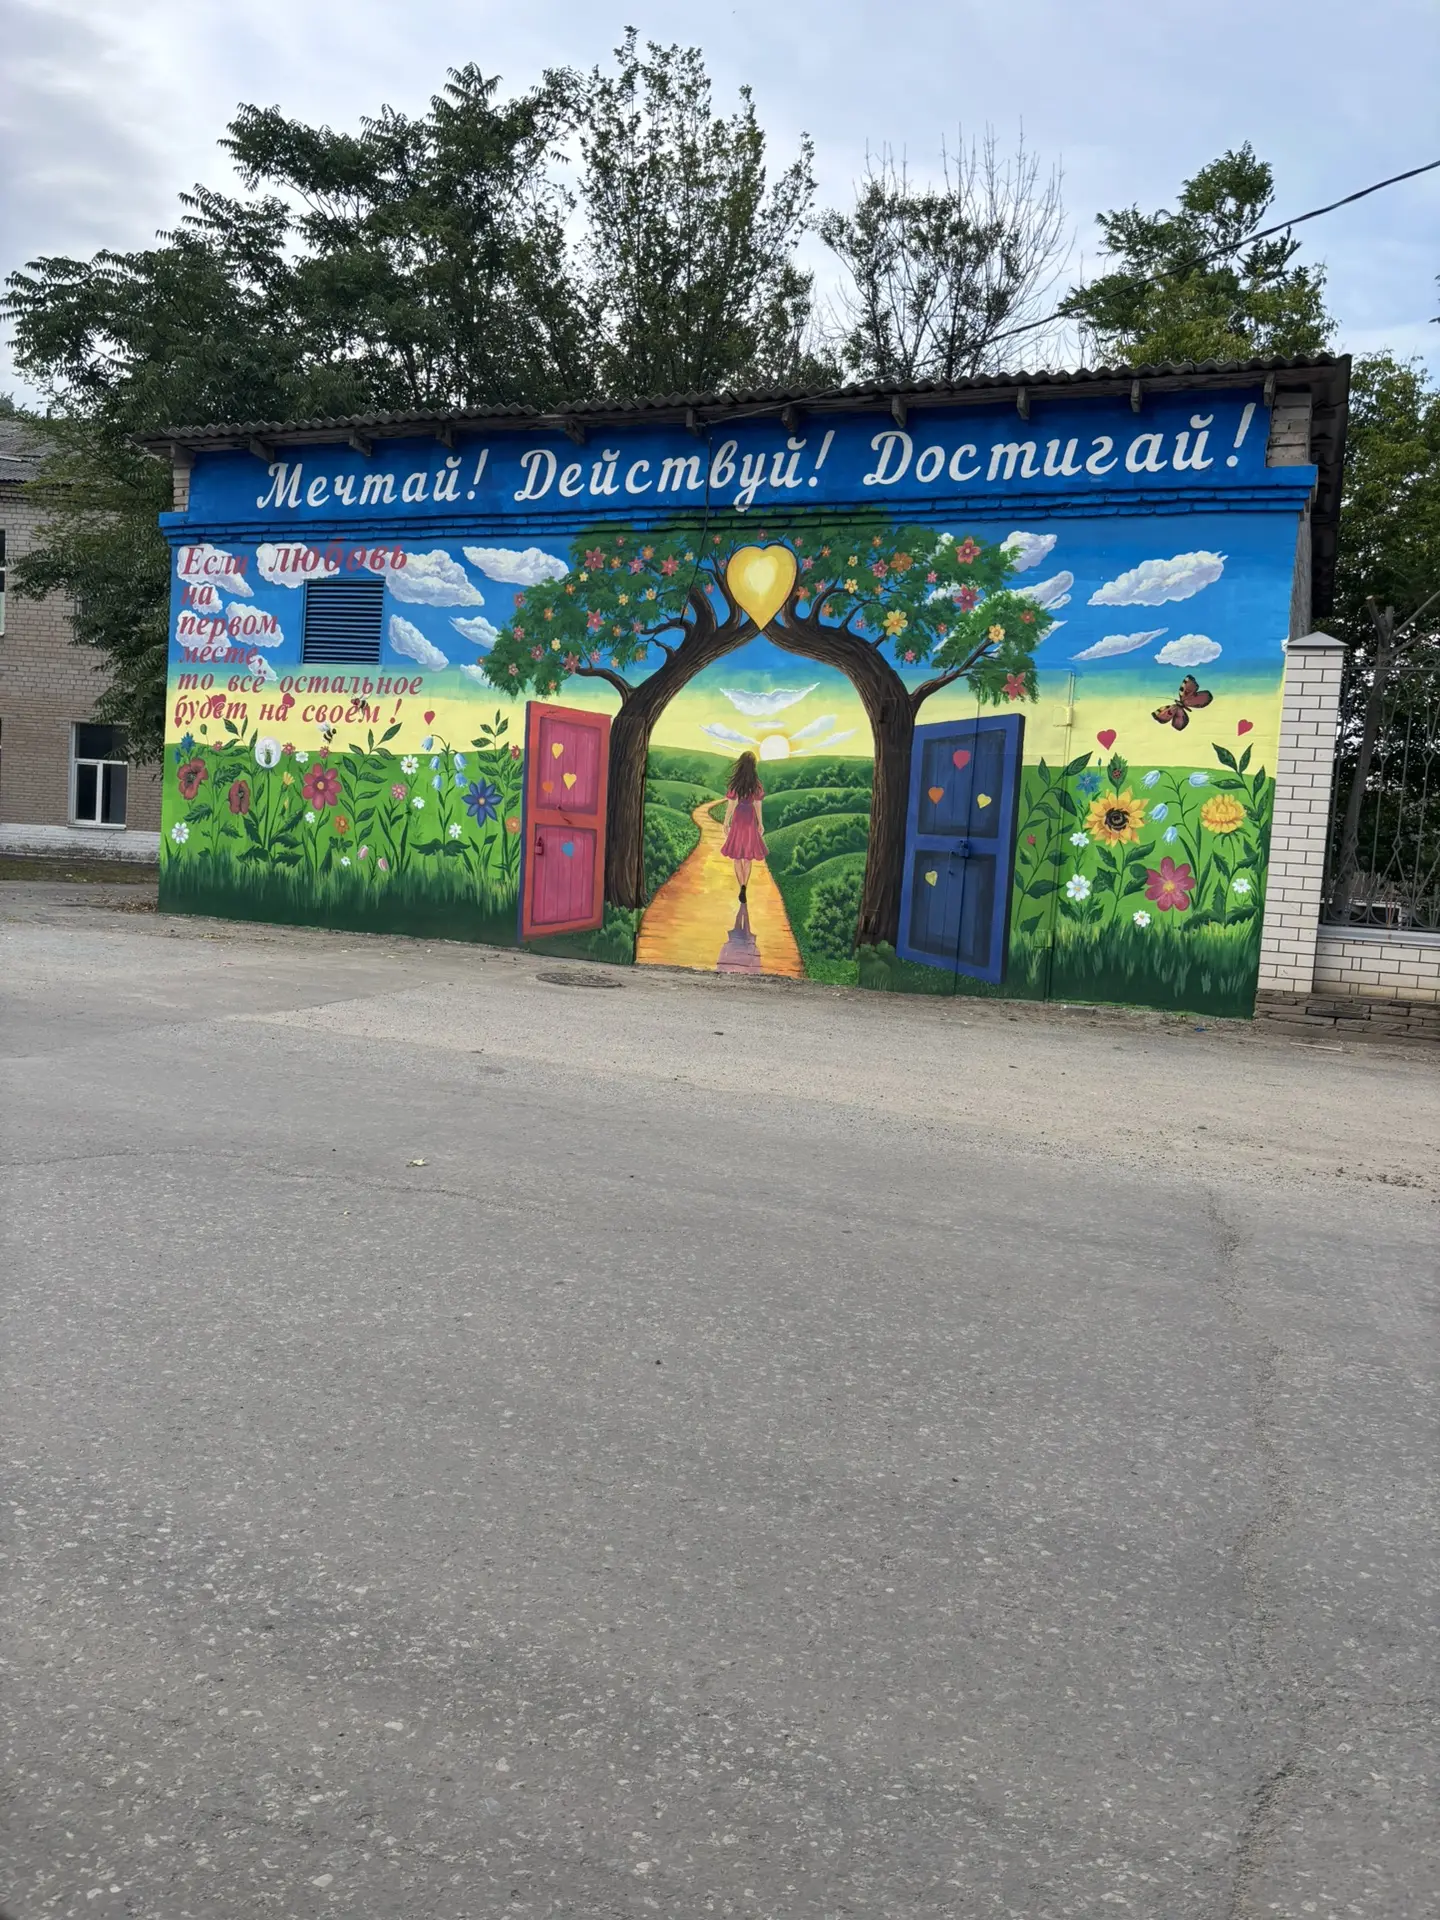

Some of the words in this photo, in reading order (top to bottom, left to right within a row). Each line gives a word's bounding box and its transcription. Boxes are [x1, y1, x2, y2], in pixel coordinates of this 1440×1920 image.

[257, 448, 489, 509] Мечтай!
[513, 429, 836, 513] Действуй!
[862, 402, 1257, 487] Достигай!
[182, 546, 248, 576] Если
[180, 584, 213, 606] на
[178, 613, 278, 644] первом
[178, 645, 263, 667] месте,
[177, 672, 214, 691] то
[227, 668, 267, 694] всё
[279, 672, 423, 696] остальное
[174, 695, 248, 725] будет
[259, 702, 289, 722] на
